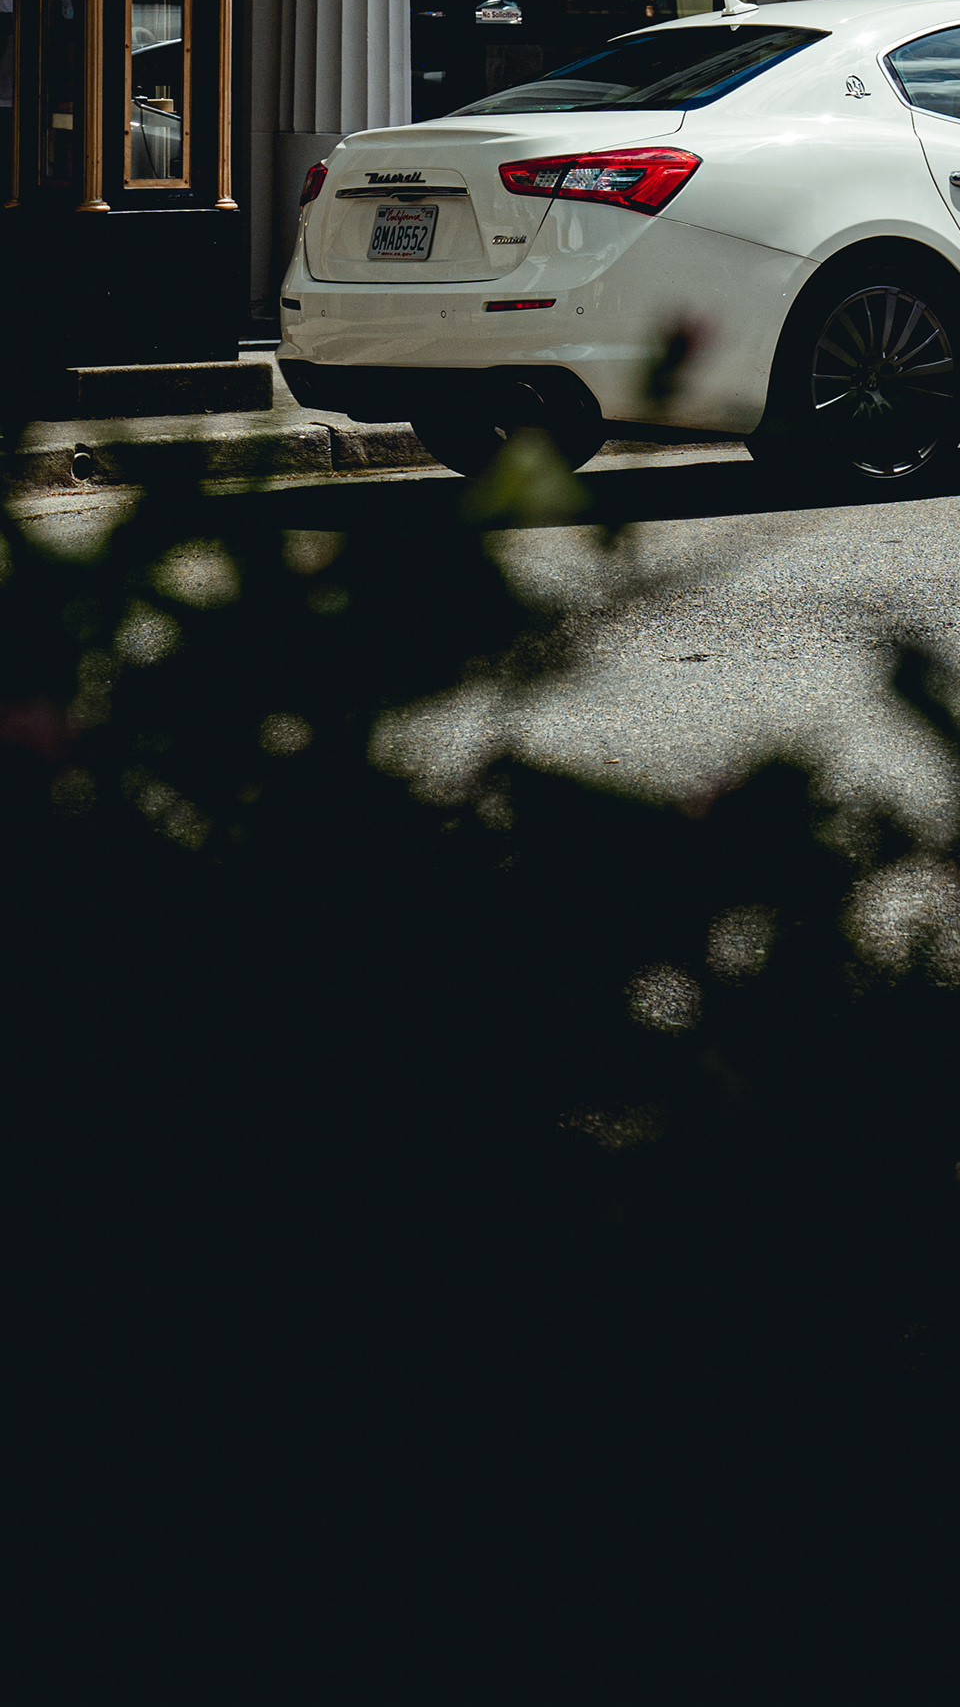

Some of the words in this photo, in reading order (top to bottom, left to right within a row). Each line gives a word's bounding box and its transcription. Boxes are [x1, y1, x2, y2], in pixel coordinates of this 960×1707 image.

[492, 11, 519, 20] Soliciting
[365, 172, 426, 184] Maserati
[386, 208, 423, 225] California
[372, 225, 428, 251] 8MAB552
